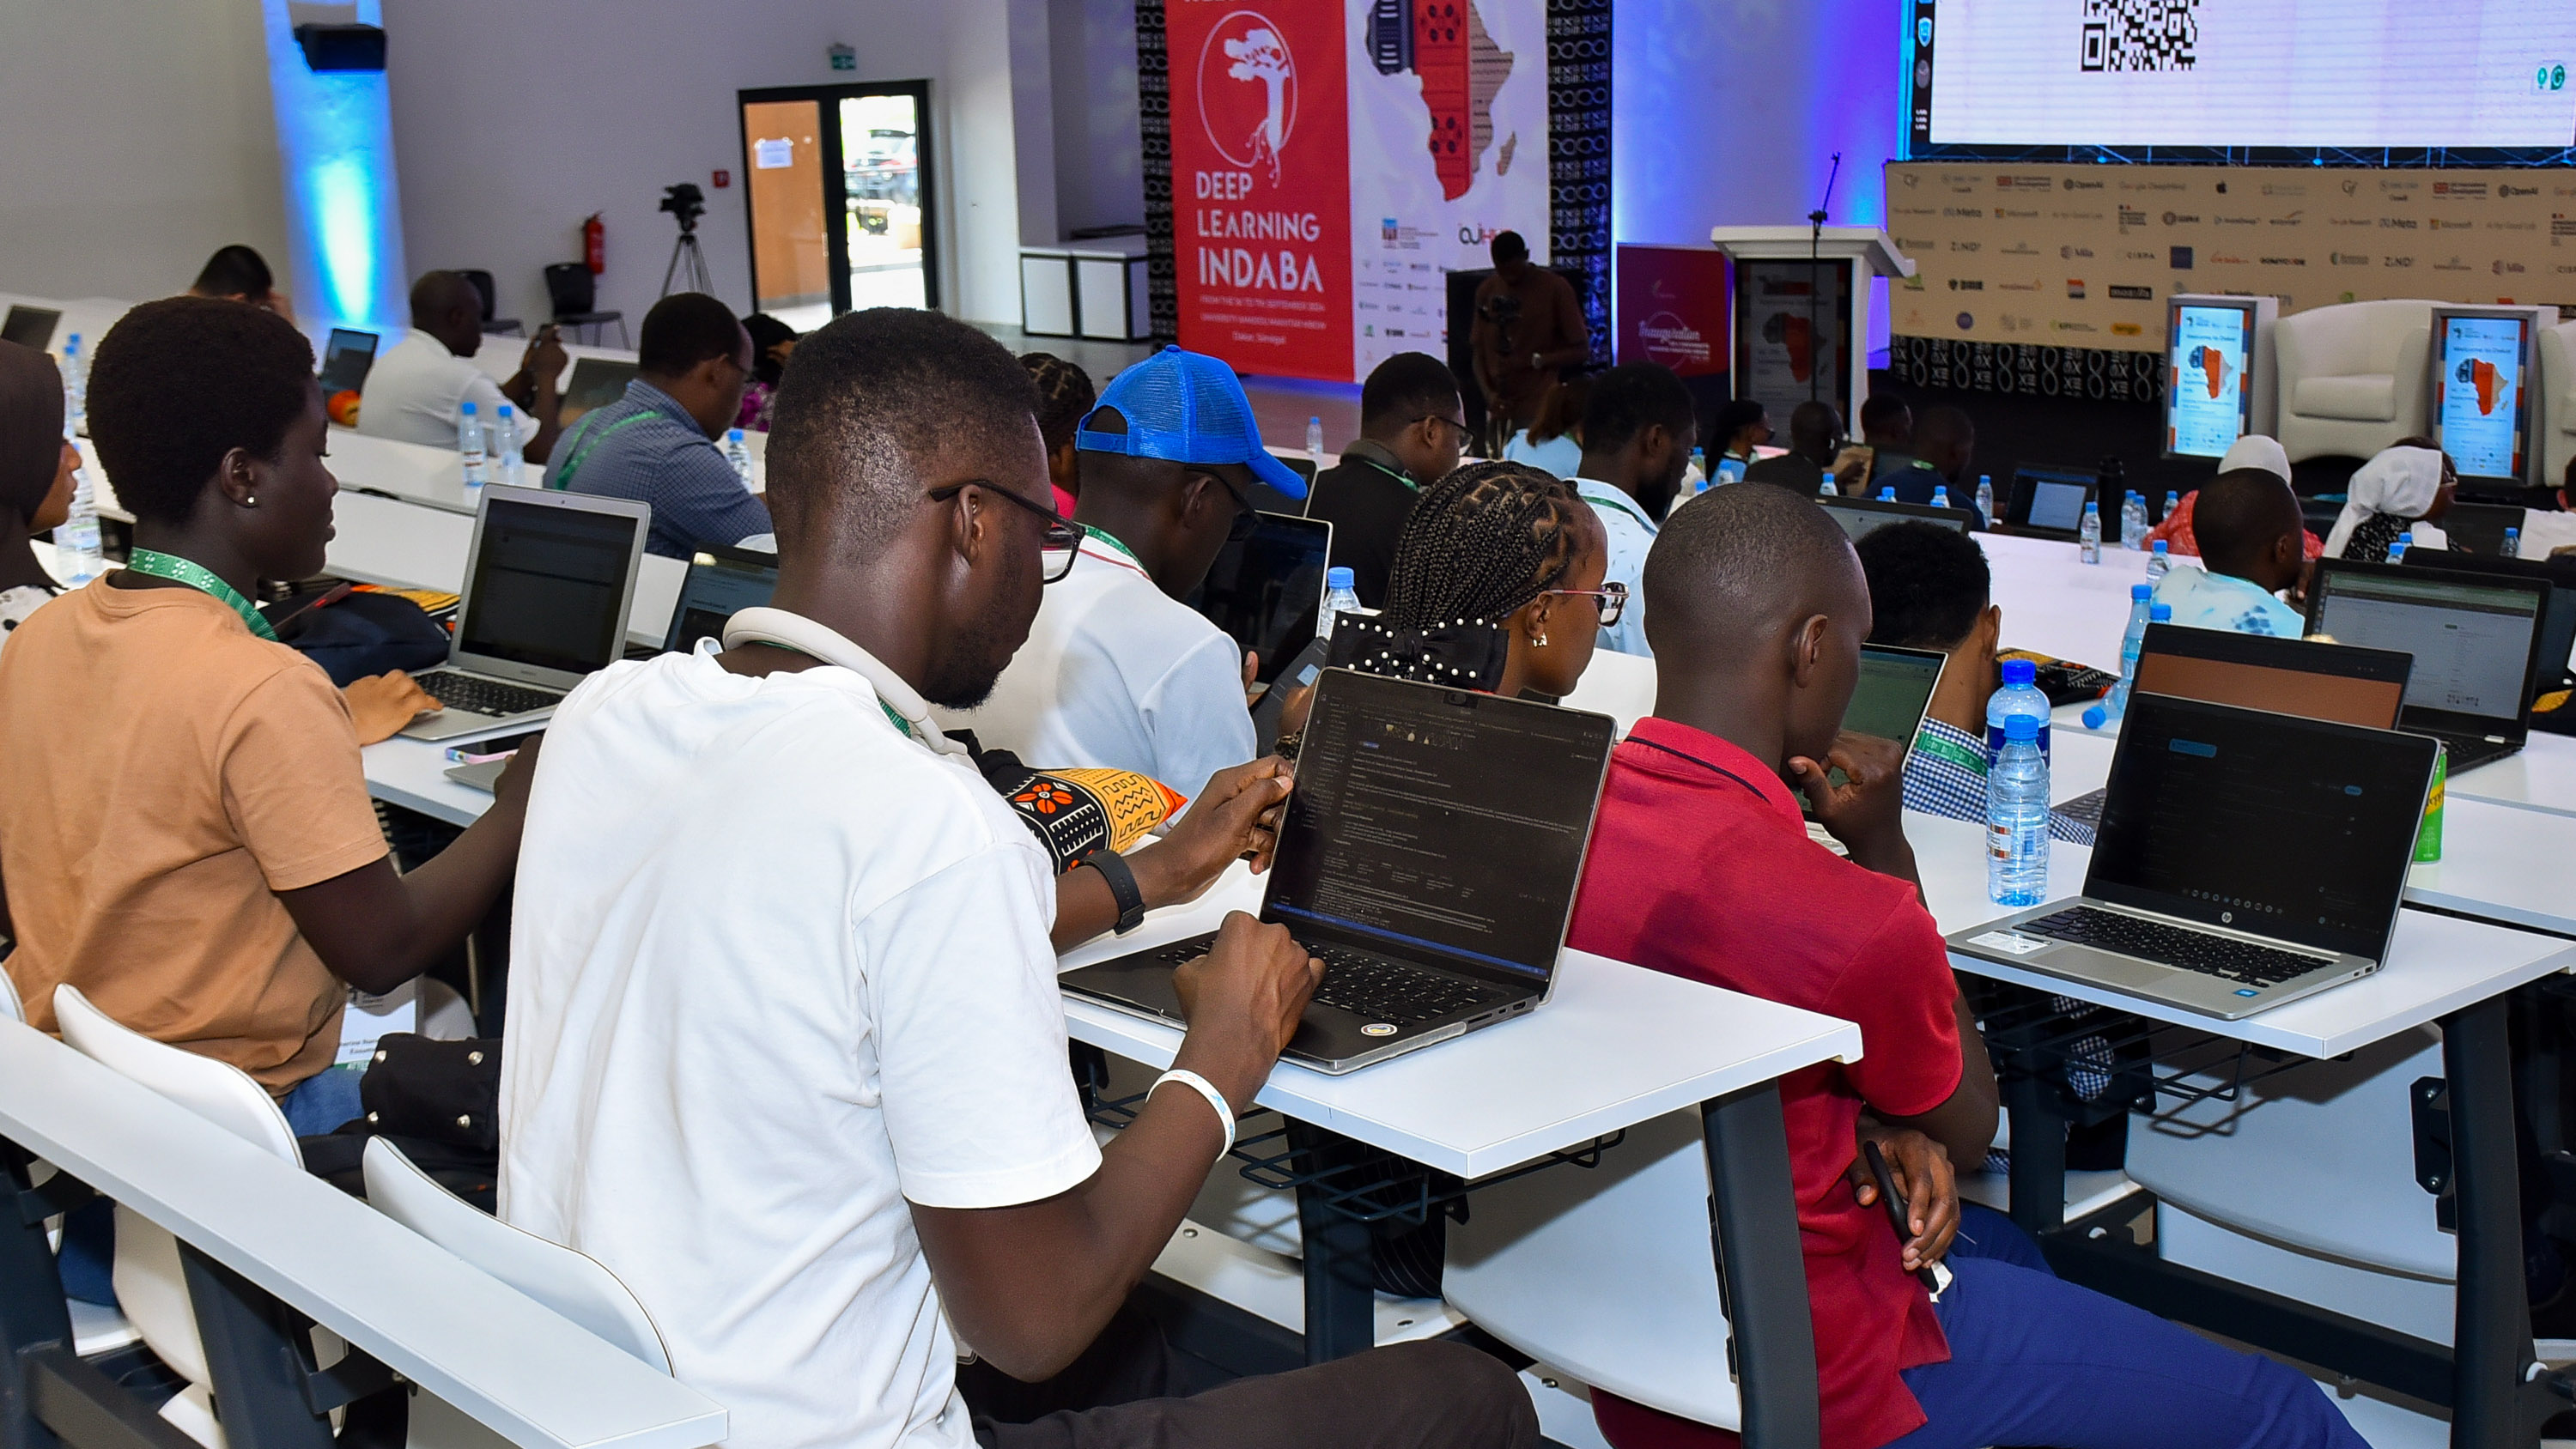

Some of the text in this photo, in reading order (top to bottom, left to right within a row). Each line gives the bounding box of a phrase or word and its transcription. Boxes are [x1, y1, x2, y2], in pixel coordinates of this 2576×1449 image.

[1196, 171, 1253, 200] DEEP
[1197, 209, 1321, 241] LEARNING
[1955, 208, 1983, 218] Meta
[2390, 218, 2418, 229] Meta
[1198, 246, 1325, 294] INDABA
